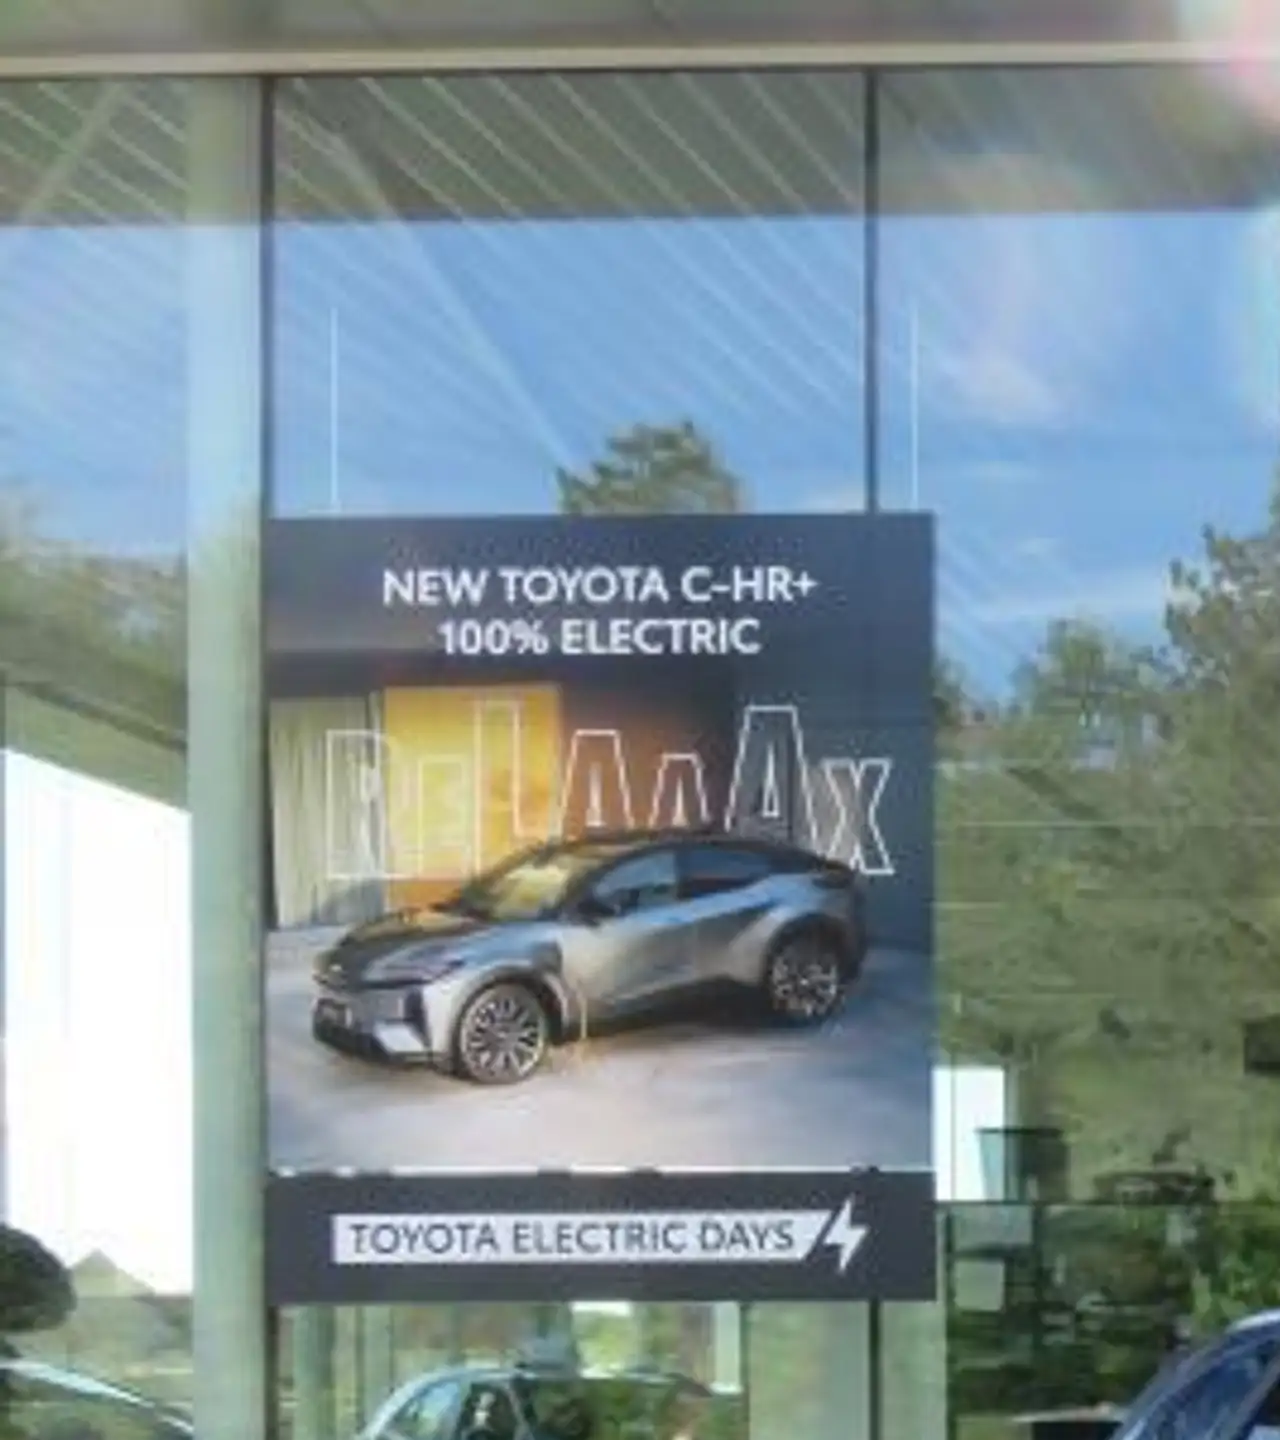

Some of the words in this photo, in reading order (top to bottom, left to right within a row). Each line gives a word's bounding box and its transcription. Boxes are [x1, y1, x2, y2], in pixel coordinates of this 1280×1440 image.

[383, 568, 487, 606] NEW
[502, 568, 669, 604] TOYOTA
[681, 566, 818, 604] C-HR+
[438, 619, 549, 656] 100%
[561, 618, 761, 656] ELECTRIC
[350, 1222, 498, 1255] TOYOTA
[513, 1221, 688, 1254] ELECTRIC
[700, 1219, 795, 1252] DAYS
